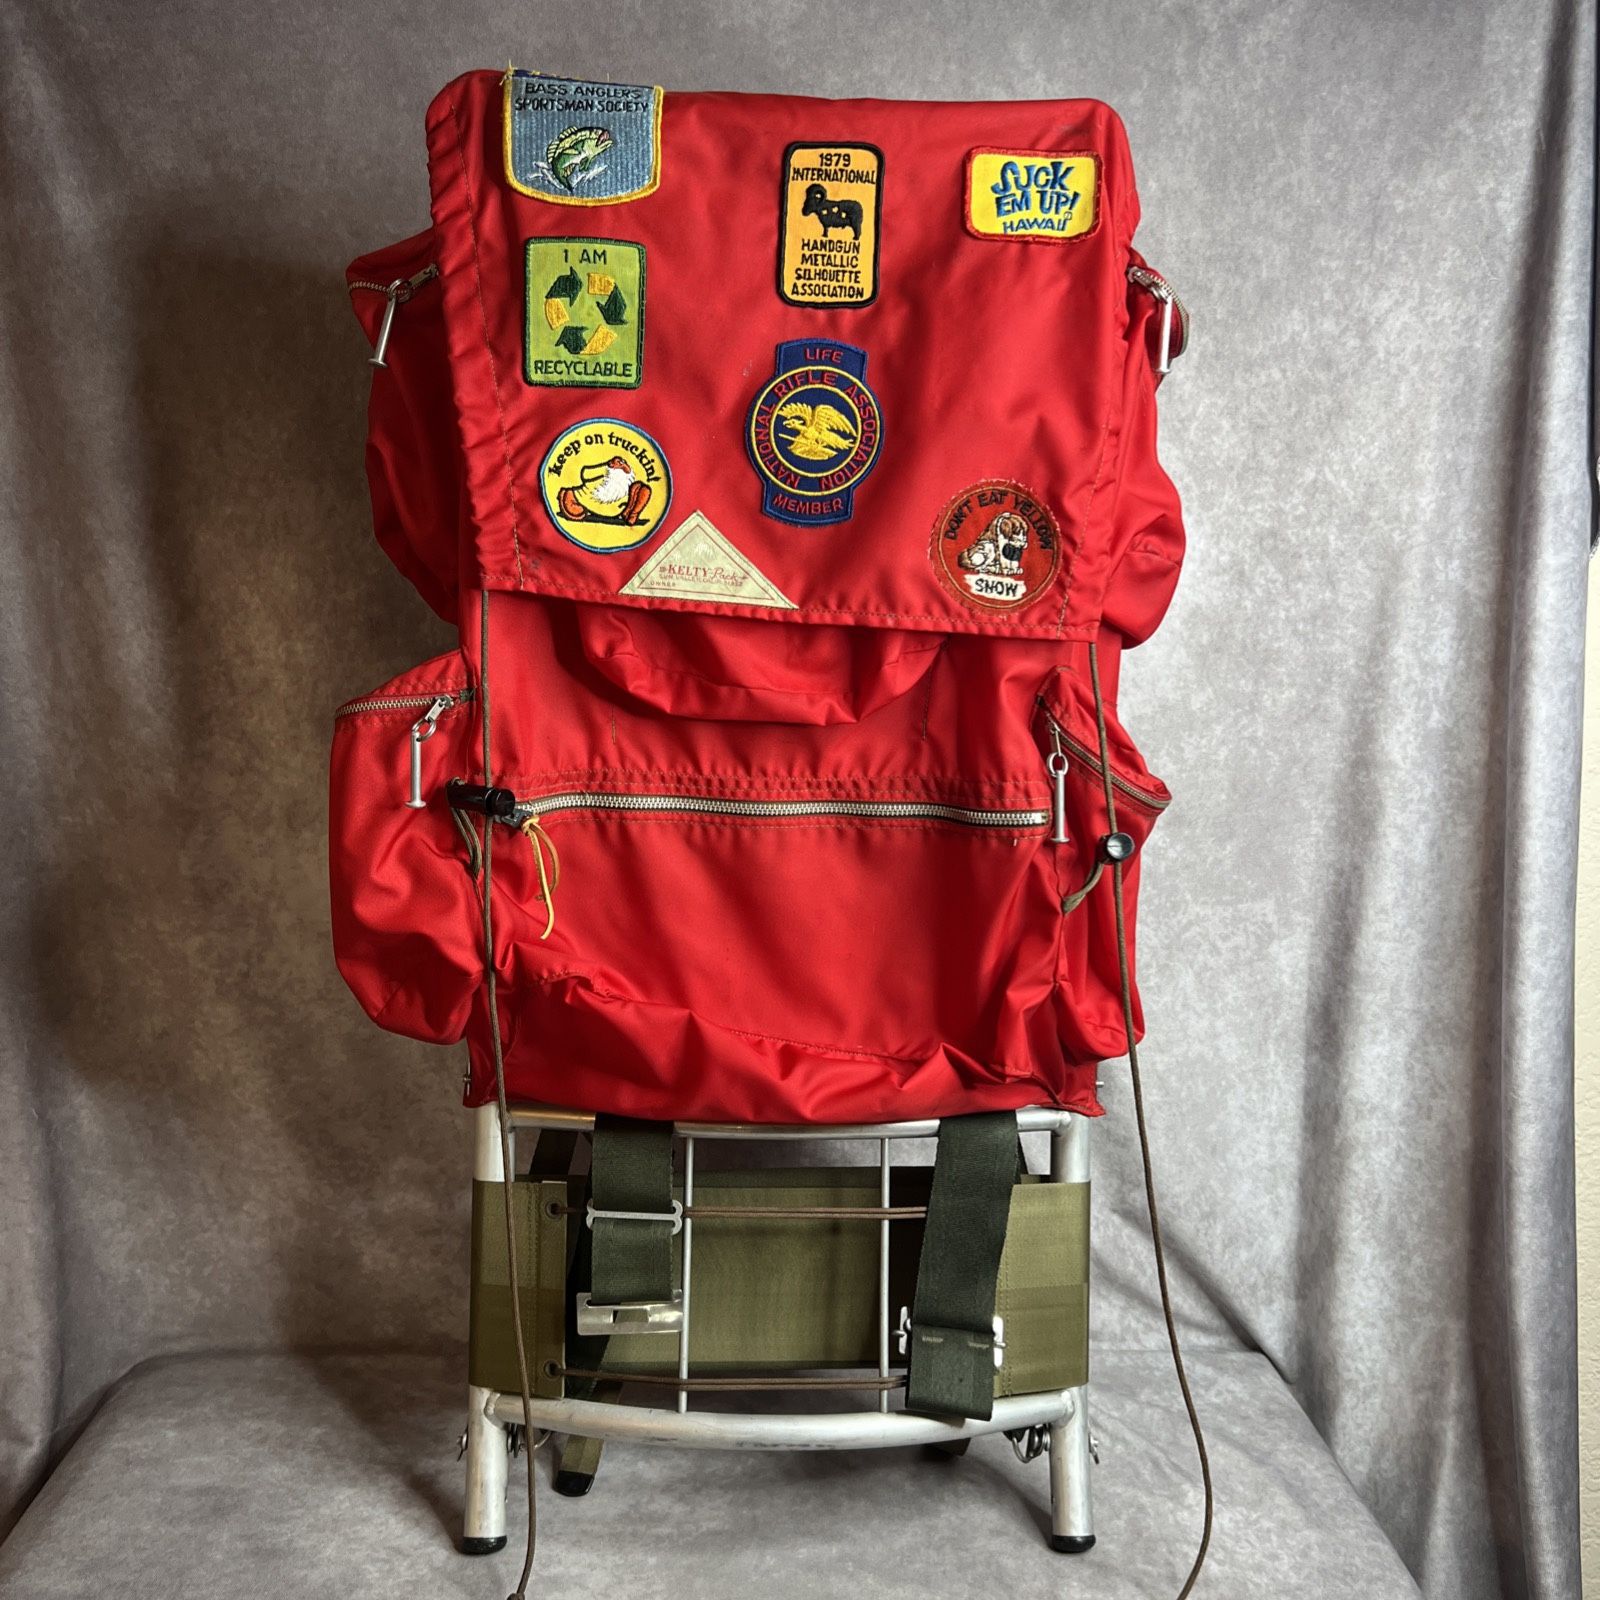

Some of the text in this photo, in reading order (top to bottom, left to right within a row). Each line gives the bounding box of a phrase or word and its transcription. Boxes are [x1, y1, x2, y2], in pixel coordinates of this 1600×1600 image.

[525, 82, 642, 99] BASS ANGLERS
[515, 97, 649, 113] SPORTSMAN SOCIETY
[819, 153, 851, 168] 1979
[792, 167, 876, 185] INTERNATIONAL
[990, 160, 1075, 195] SUCK
[995, 190, 1081, 218] EM UP!
[1002, 218, 1067, 234] HAWAII
[801, 239, 860, 254] HANDGUN
[563, 249, 607, 265] I AM
[800, 253, 859, 268] METALLIC
[795, 268, 861, 284] SILHOUETTE
[791, 283, 864, 299] ASSOCIATION
[805, 348, 844, 364] LIFE
[534, 359, 633, 377] RECYCLABLE
[754, 370, 876, 491] NATIONAL RIFLE ASSOCIATION
[548, 439, 581, 477] keep
[584, 433, 604, 445] on
[773, 493, 844, 515] MEMBER
[977, 489, 1009, 507] EAT
[1013, 494, 1053, 550] YELLOW
[668, 564, 737, 580] KELTY Pack
[975, 578, 1019, 597] SNOW
